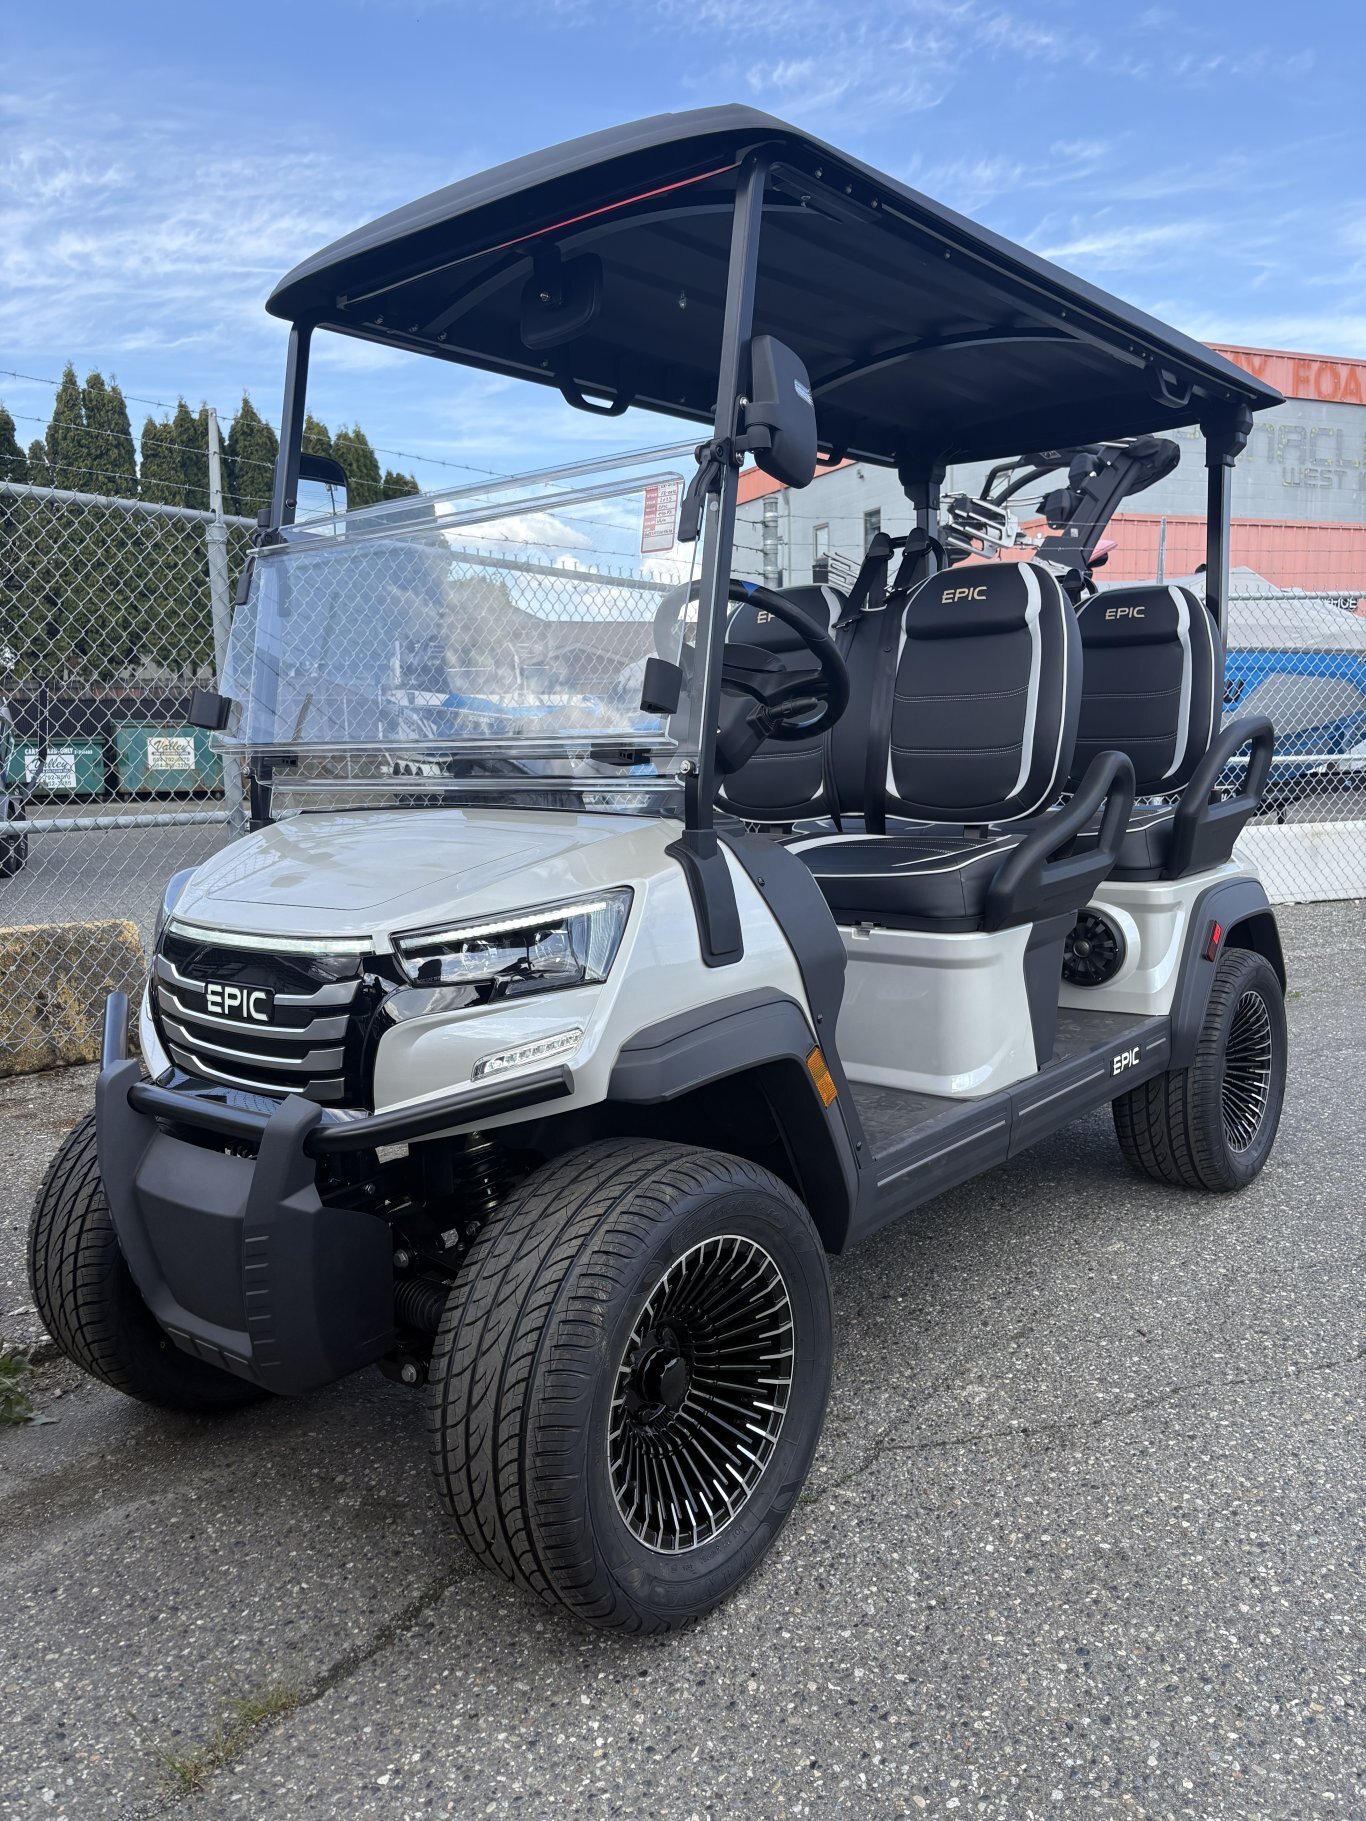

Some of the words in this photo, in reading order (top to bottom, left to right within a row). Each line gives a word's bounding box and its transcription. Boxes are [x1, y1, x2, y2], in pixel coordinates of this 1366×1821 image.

[1282, 467, 1347, 489] WEST
[941, 586, 987, 603] EPIC
[1105, 606, 1145, 620] EPIC
[154, 740, 187, 752] Valley
[206, 984, 269, 1021] EPIC
[1113, 1047, 1140, 1076] EPIC
